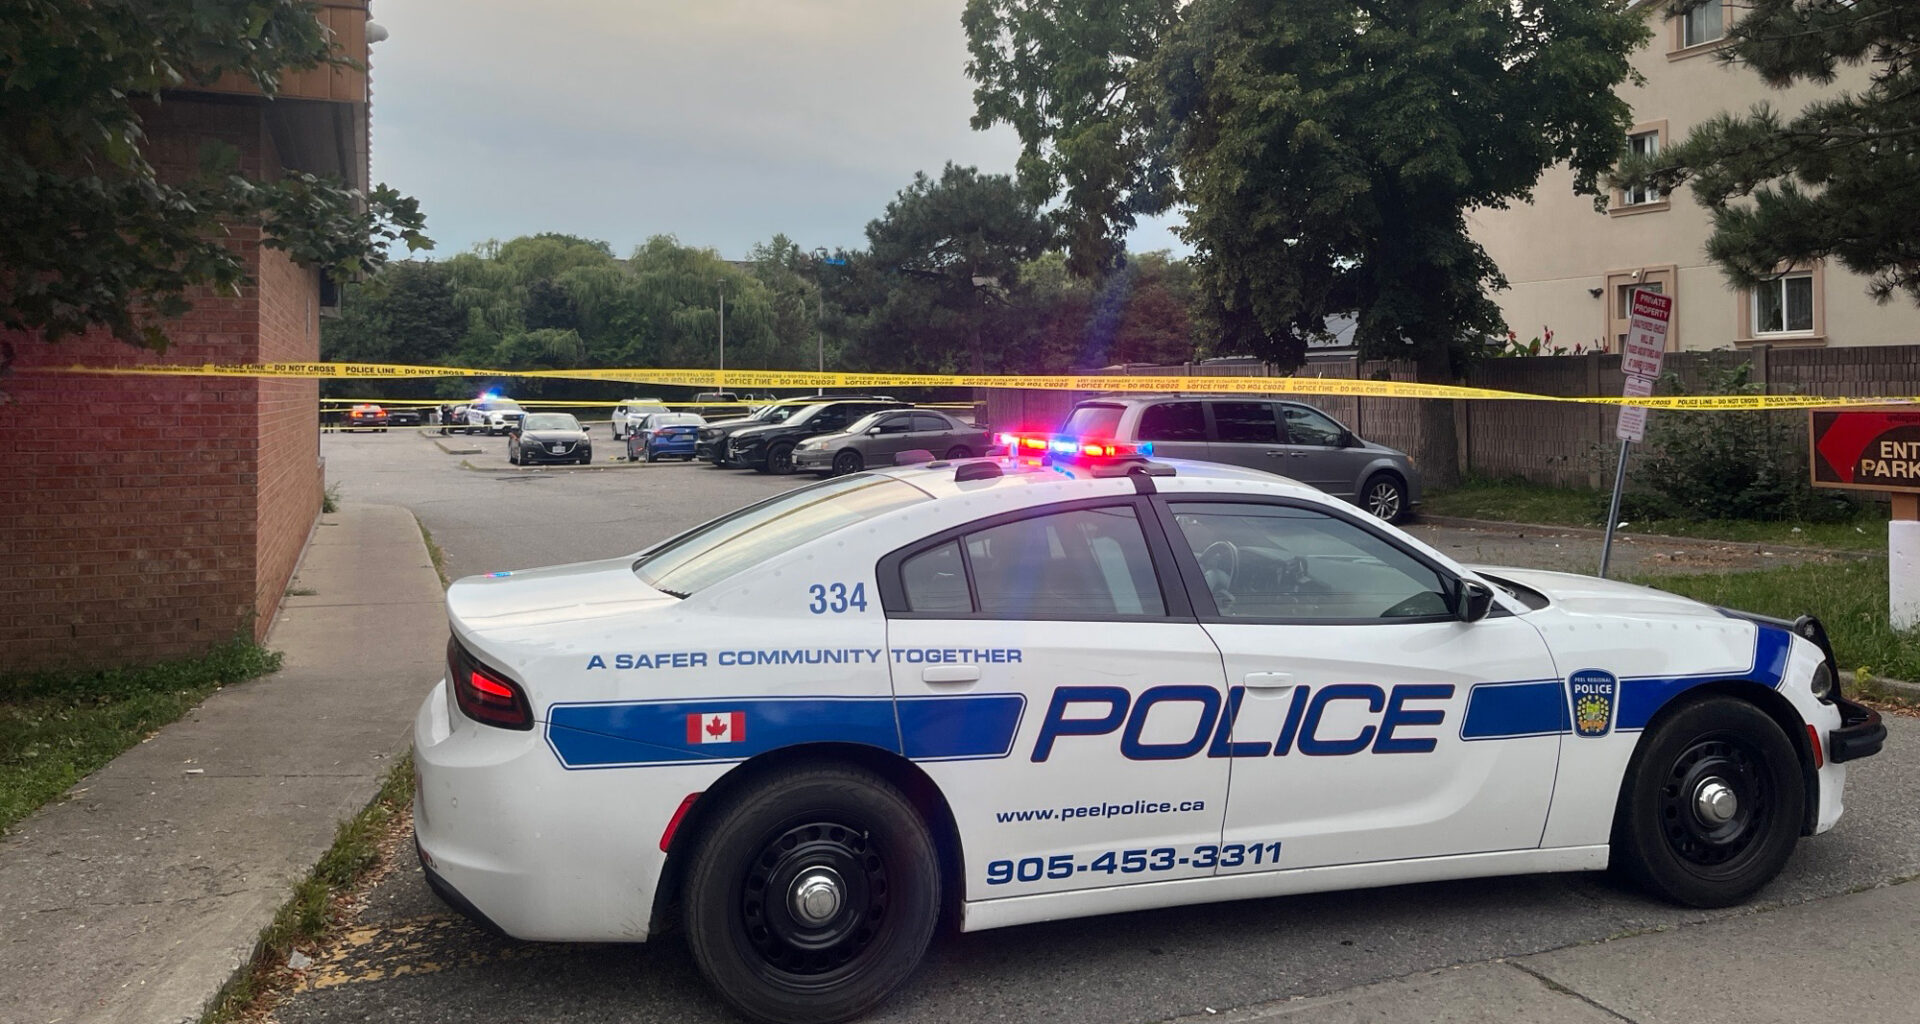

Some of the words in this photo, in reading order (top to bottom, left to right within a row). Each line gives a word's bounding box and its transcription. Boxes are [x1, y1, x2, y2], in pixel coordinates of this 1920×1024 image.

[1634, 303, 1669, 318] PROPERTY
[1640, 294, 1667, 307] PRIVATE
[1880, 440, 1920, 460] ENT
[1861, 459, 1920, 479] PARK
[809, 582, 868, 614] 334
[586, 655, 607, 670] A
[615, 652, 708, 669] SAFER
[718, 648, 882, 667] COMMUNITY
[891, 648, 1023, 664] TOGETHER
[1574, 684, 1612, 694] POLICE
[1030, 683, 1456, 763] POLICE
[996, 799, 1206, 824] www.peelpolice.ca
[986, 841, 1283, 886] 905-453-3311
